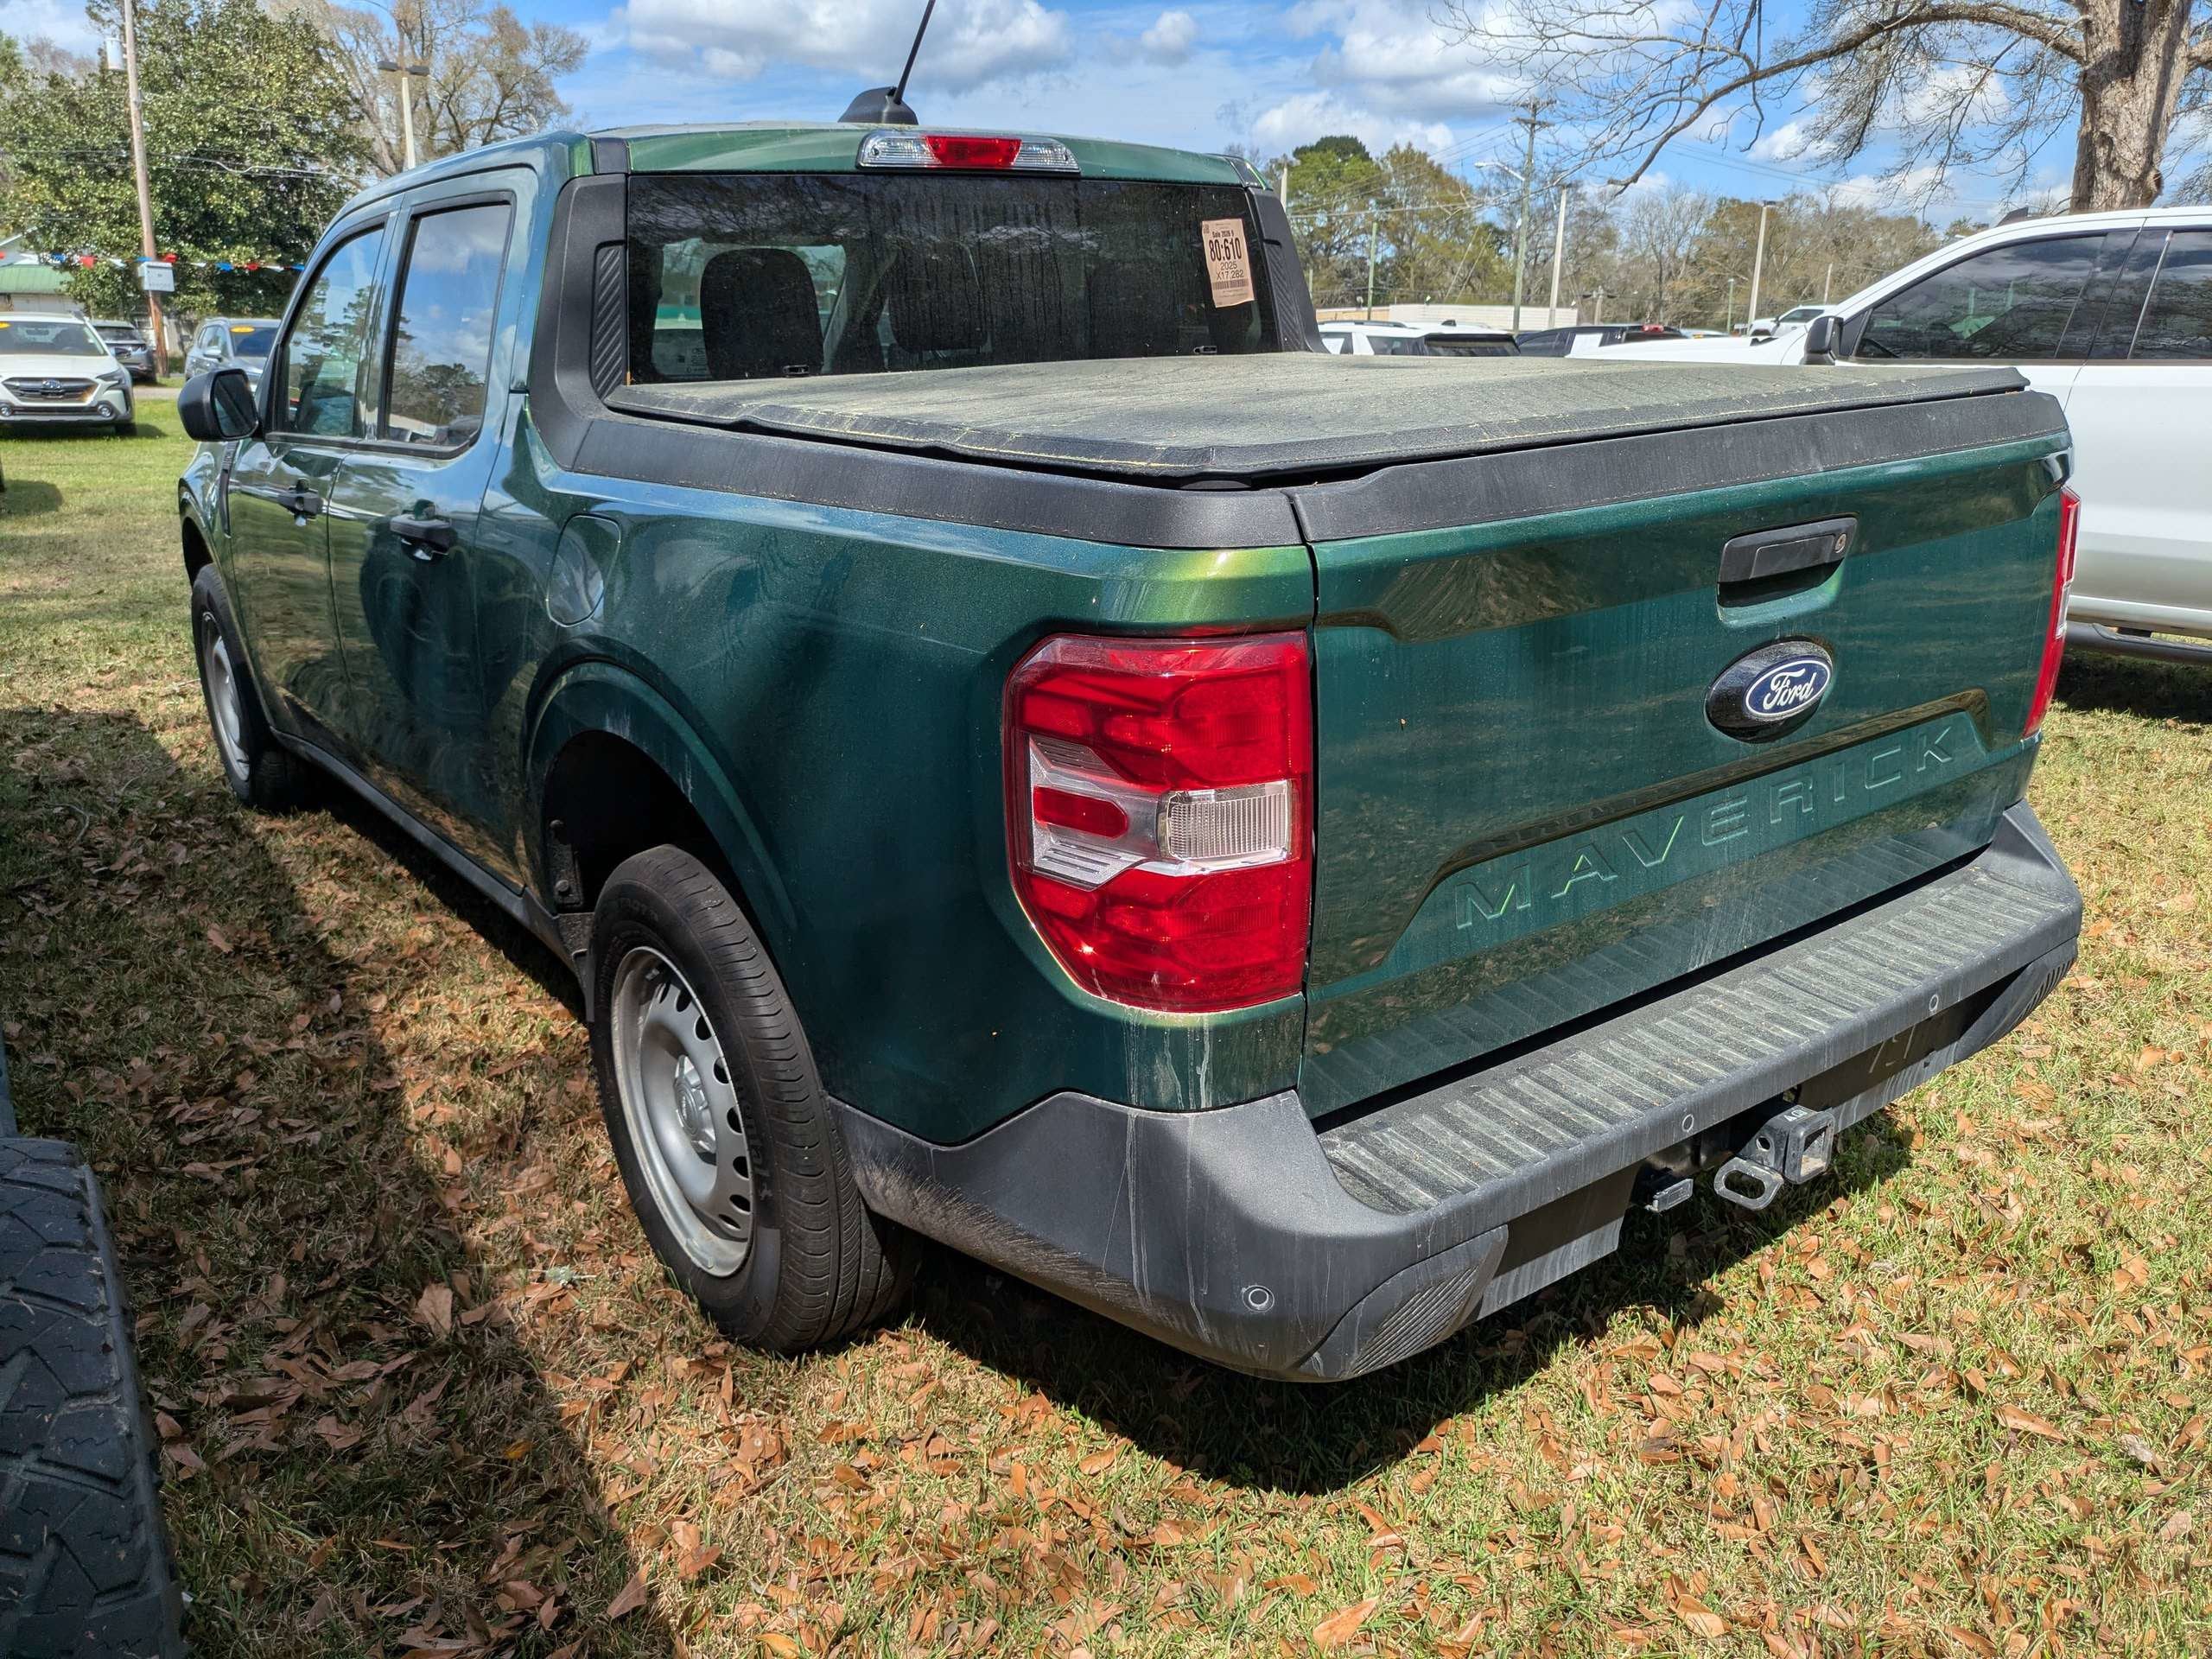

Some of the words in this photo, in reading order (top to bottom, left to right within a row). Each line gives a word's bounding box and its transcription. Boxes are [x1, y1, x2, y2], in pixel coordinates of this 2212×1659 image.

[1209, 238, 1242, 262] 80:610
[1220, 261, 1237, 270] 2025
[1763, 668, 1817, 710] Ford
[1454, 725, 1952, 930] MAVERICK
